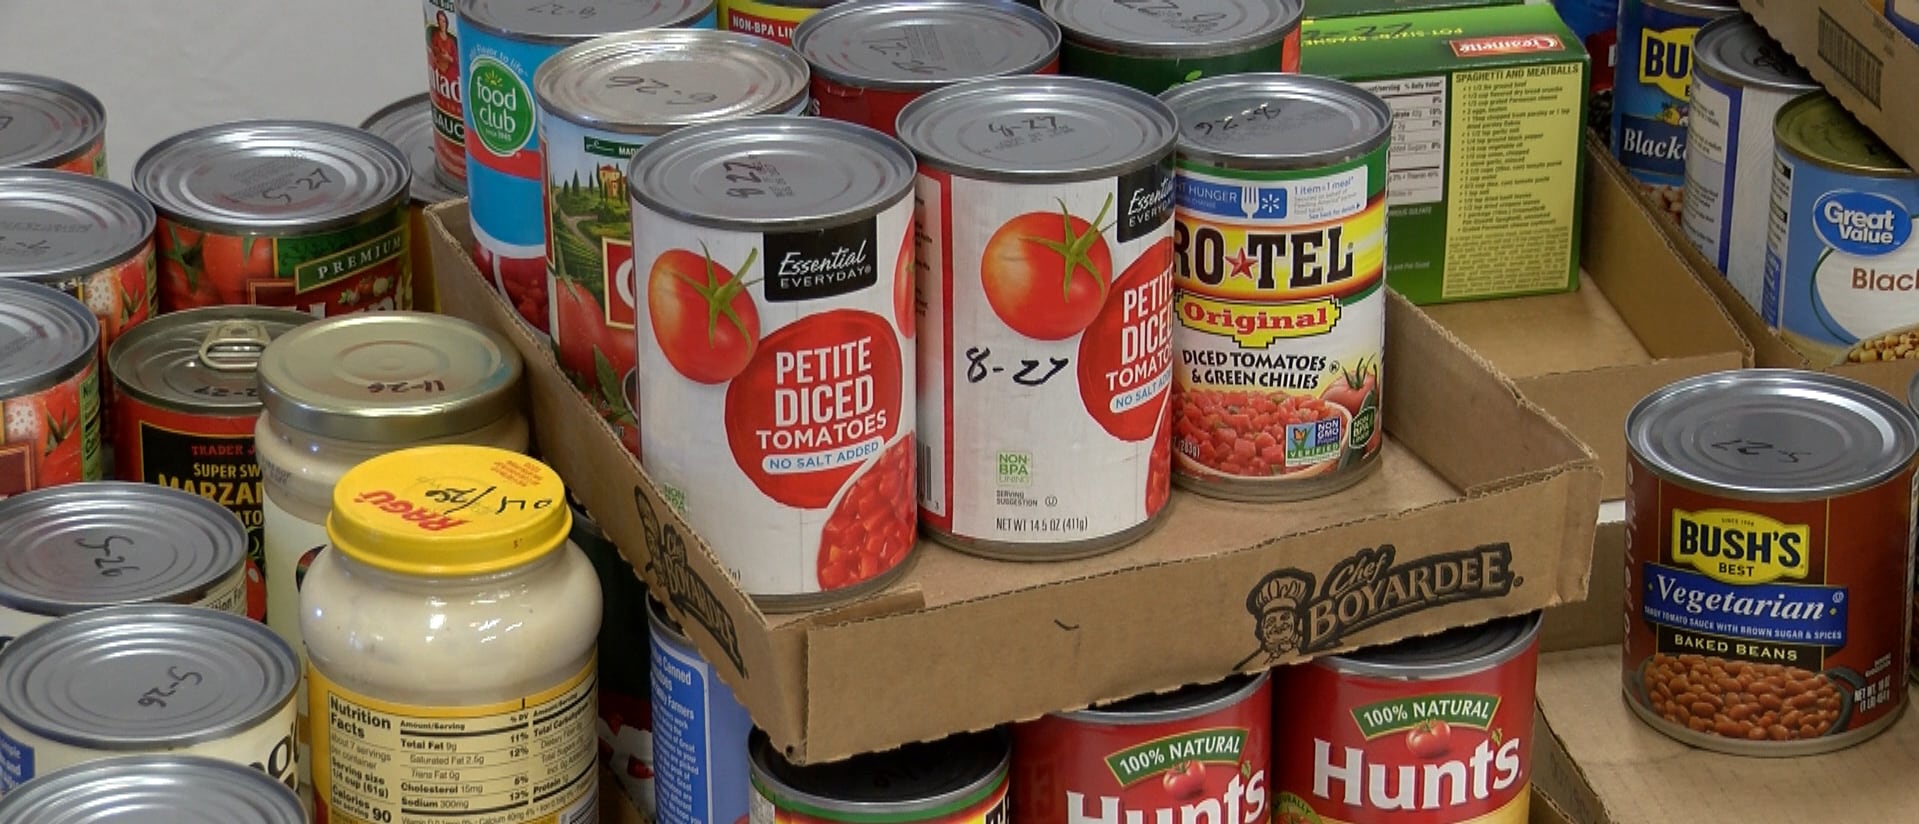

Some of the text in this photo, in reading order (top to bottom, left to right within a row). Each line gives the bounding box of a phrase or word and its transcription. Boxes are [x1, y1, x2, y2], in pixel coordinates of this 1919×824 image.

[732, 15, 774, 37] NON-BPA
[1645, 36, 1692, 79] BU
[1456, 64, 1579, 83] SPAGHETTI AND MEATBALLS
[477, 76, 517, 111] food
[480, 104, 516, 133] club
[619, 146, 640, 156] MAD
[1623, 128, 1688, 161] Black
[1189, 184, 1237, 203] HUNGER
[1824, 200, 1895, 231] Great
[1838, 223, 1893, 244] Value
[317, 235, 401, 280] PREMIUM
[778, 239, 867, 276] Essential
[1184, 301, 1328, 334] Original
[776, 336, 872, 385] PETITE
[965, 345, 1069, 388] 8-27
[1183, 350, 1326, 371] DICED TOMATOES
[1192, 370, 1318, 389] & GREEN CHILIES
[775, 374, 874, 427] DICED
[1116, 380, 1157, 409] NO SALT
[756, 409, 887, 449] TOMATOES
[1317, 428, 1339, 440] GMO
[1318, 419, 1339, 431] NON
[191, 445, 244, 456] TRADER
[769, 441, 879, 470] NO SALT ADDED
[193, 462, 236, 479] SUPER
[999, 464, 1028, 475] BPA
[996, 498, 1038, 507] SUGGESTION
[996, 518, 1012, 531] NET
[1013, 518, 1027, 531] WT
[1050, 518, 1061, 531] OZ
[1062, 516, 1088, 532] (411g)
[1680, 518, 1801, 569] BUSH'S
[1329, 552, 1387, 597] Chef
[1719, 561, 1755, 578] BEST
[1309, 551, 1506, 643] BOYARDEE
[1656, 573, 1825, 620] Vegetarian
[1662, 609, 1688, 625] TOMATO
[1689, 617, 1714, 630] SAUCE
[1716, 622, 1738, 634] WITH
[1740, 626, 1772, 638] BROWN
[1775, 629, 1802, 640] SUGAR
[1814, 630, 1842, 640] SPICES
[1674, 633, 1798, 661] BAKED BEANS
[331, 695, 391, 731] Nutrition
[519, 712, 528, 721] DV
[1363, 699, 1489, 728] 100% NATURAL
[331, 712, 364, 739] Facts
[400, 719, 465, 731] Amount/Serving
[534, 724, 552, 738] Total
[400, 738, 457, 753] Total Fat 9g
[510, 732, 528, 743] 11%
[343, 752, 376, 769] container
[357, 746, 391, 763] servings
[410, 754, 484, 766] Saturated Fat 2.5g
[510, 746, 529, 758] 12%
[1119, 735, 1240, 775] 100% NATURAL
[332, 756, 385, 785] Serving size
[411, 769, 460, 781] Trans Fat 0g
[332, 768, 389, 799] 1/4 cup (61g)
[400, 782, 483, 794] Cholesterol 15mg
[534, 777, 560, 794] Protein
[332, 783, 392, 823] Calories 90
[401, 796, 469, 810] Sodium 300mg
[510, 791, 528, 802] 13%
[343, 800, 369, 819] serving
